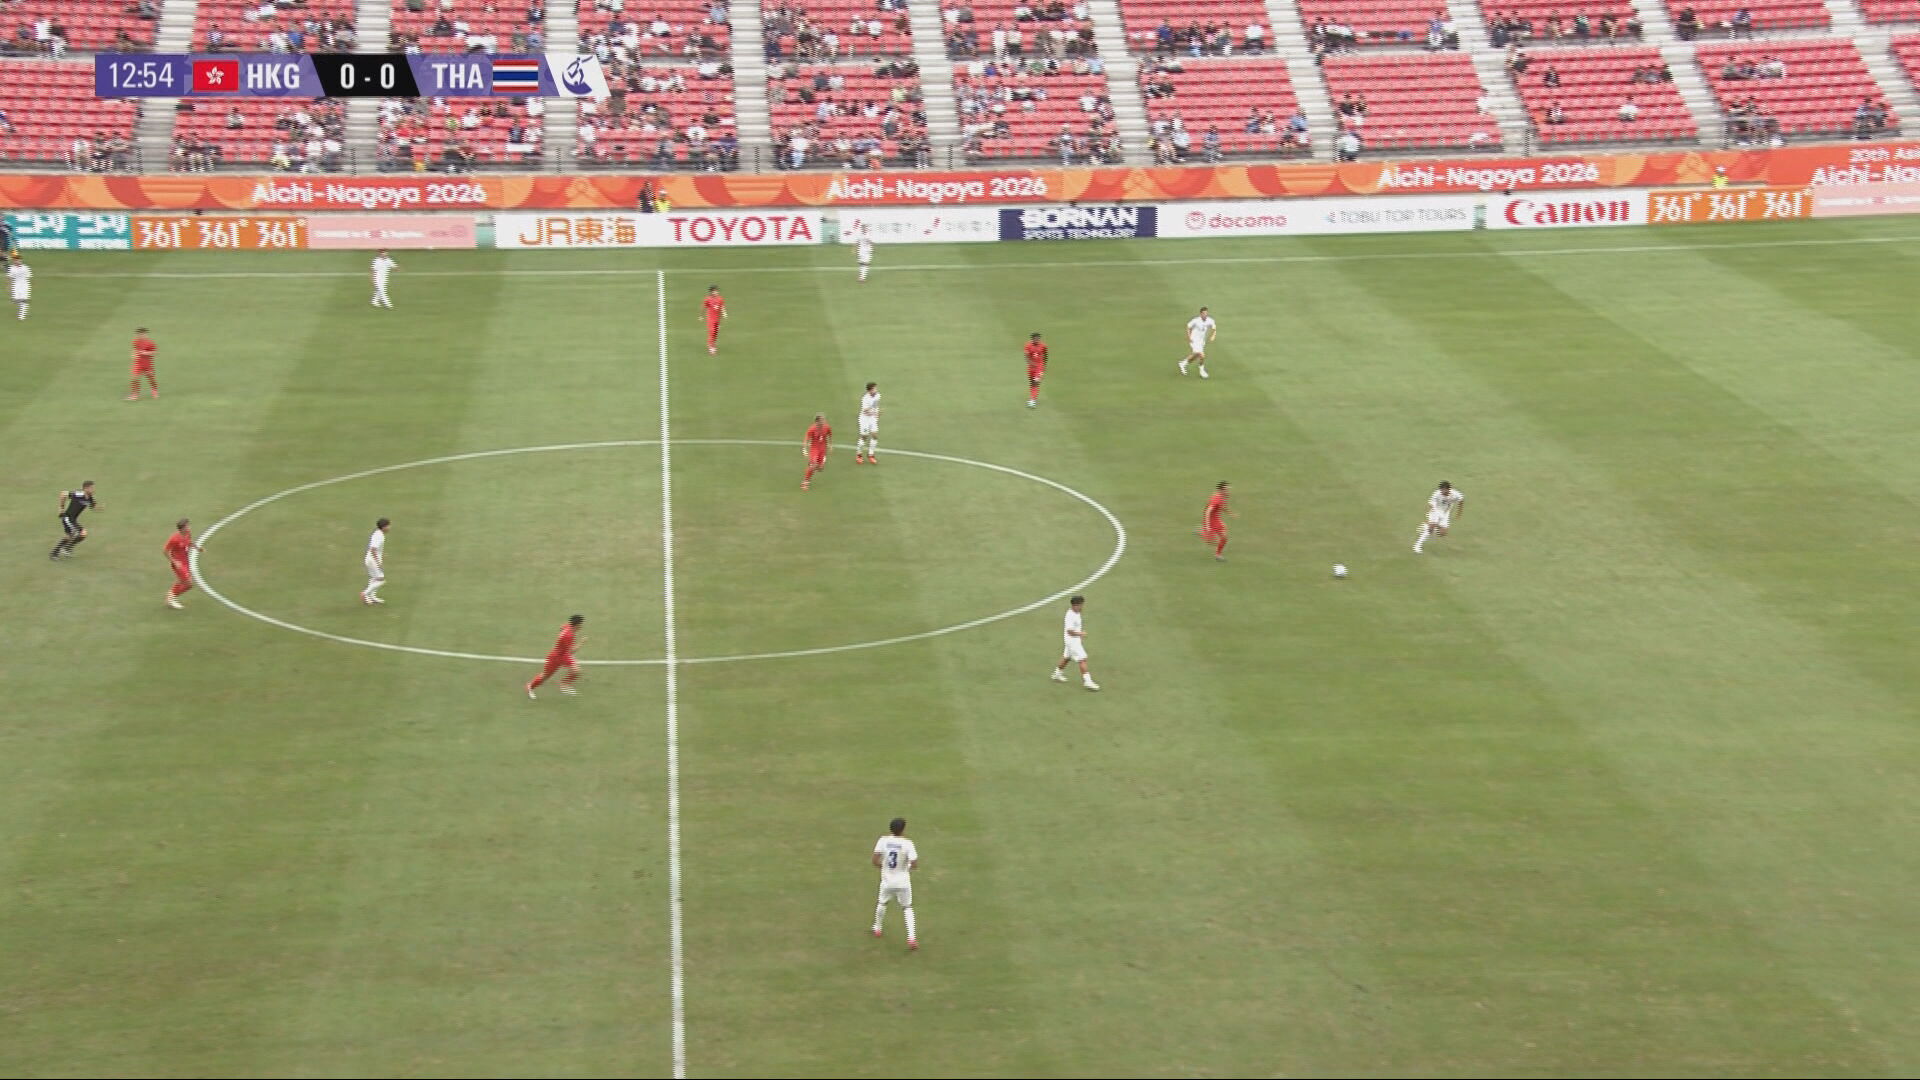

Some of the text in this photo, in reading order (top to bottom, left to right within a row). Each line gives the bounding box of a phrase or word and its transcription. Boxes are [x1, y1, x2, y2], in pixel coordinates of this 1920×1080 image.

[1848, 145, 1920, 163] 20th Asi
[1377, 162, 1600, 191] Aichi-Nagoya 2026
[252, 180, 488, 209] Aichi-Nagoya 2026
[826, 176, 1048, 204] Aichi-Nagoya 2026
[1018, 206, 1139, 228] BORNAN
[1208, 213, 1288, 228] docomo
[1339, 208, 1467, 225] TOBU TOP TOURS
[1503, 199, 1631, 226] Canon
[519, 216, 637, 245] JR東海
[667, 216, 813, 242] TOYOTA
[1022, 228, 1138, 240] SPORTS TECHNOLOGY
[887, 851, 898, 869] 3
